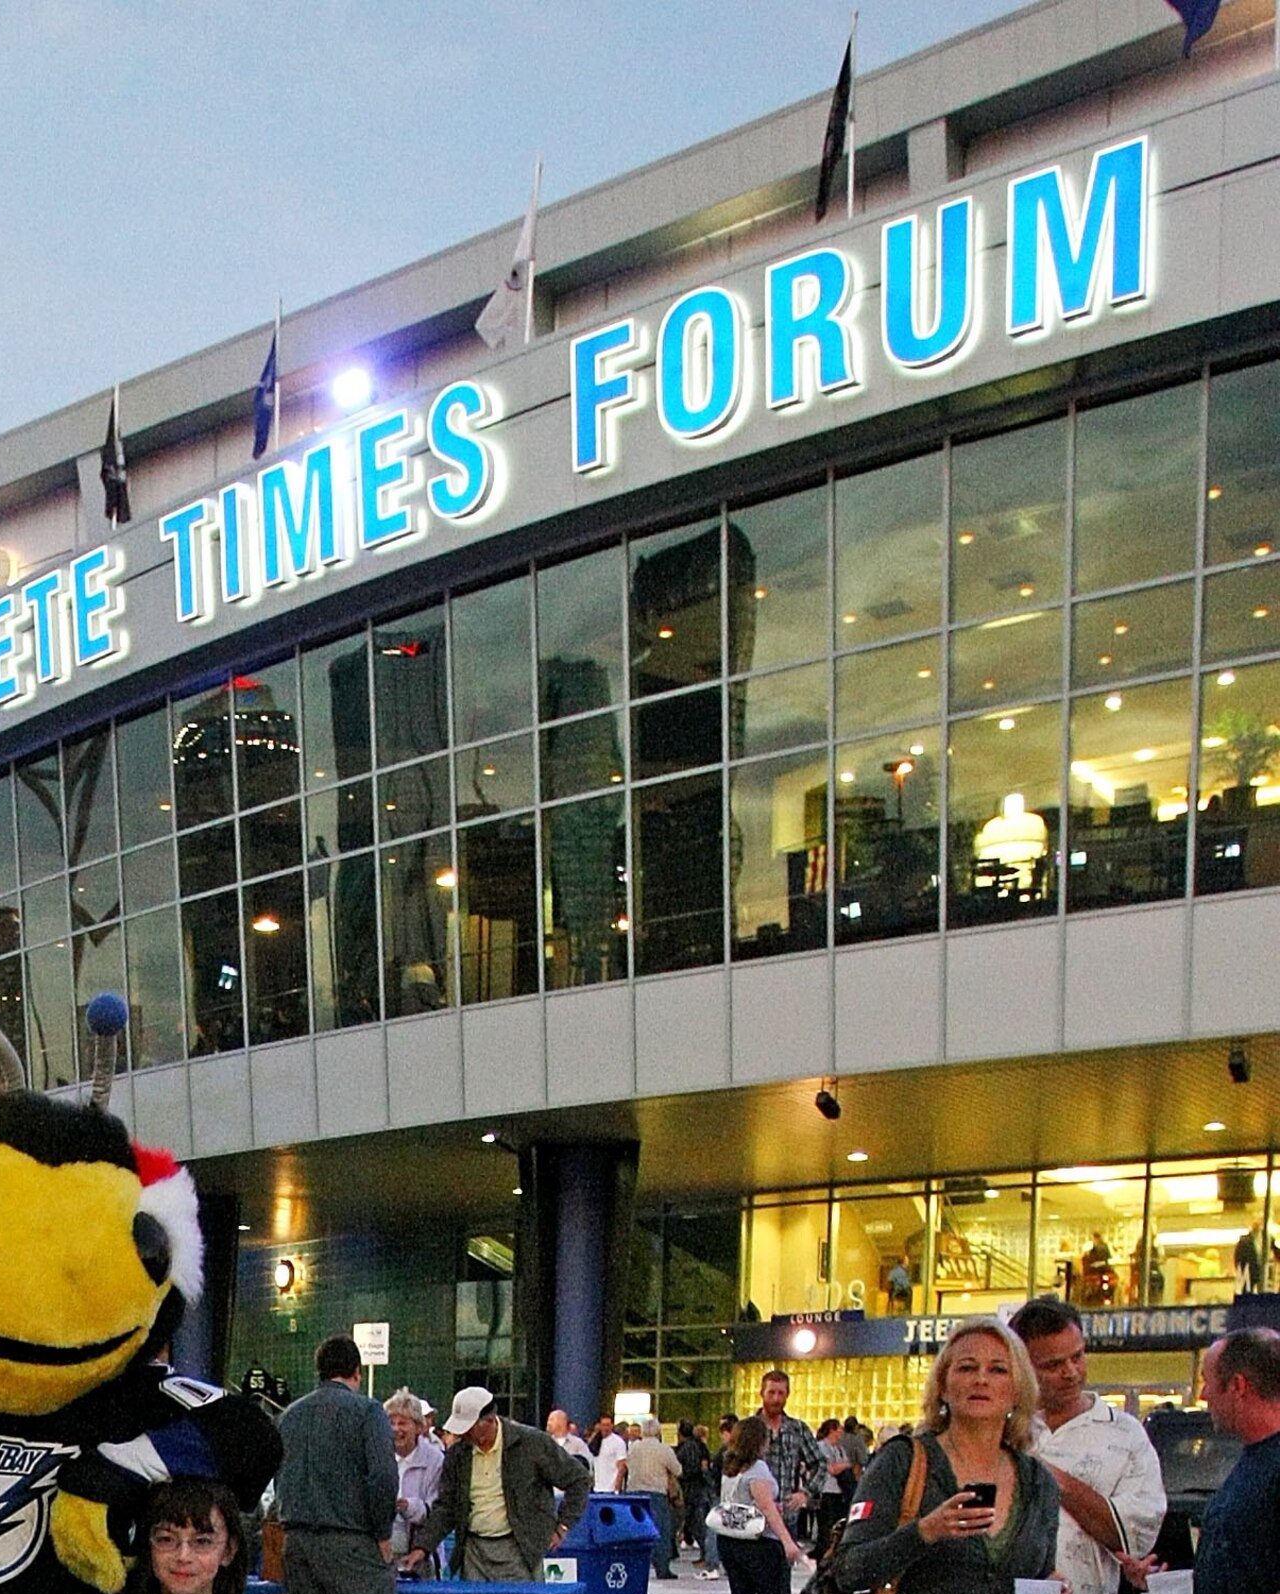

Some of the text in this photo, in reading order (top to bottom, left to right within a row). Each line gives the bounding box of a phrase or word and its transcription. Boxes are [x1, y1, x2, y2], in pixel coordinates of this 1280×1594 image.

[160, 380, 500, 625] TIMES
[570, 134, 1152, 475] FORUM
[789, 1310, 842, 1325] LOUNGE
[250, 1376, 265, 1389] 55
